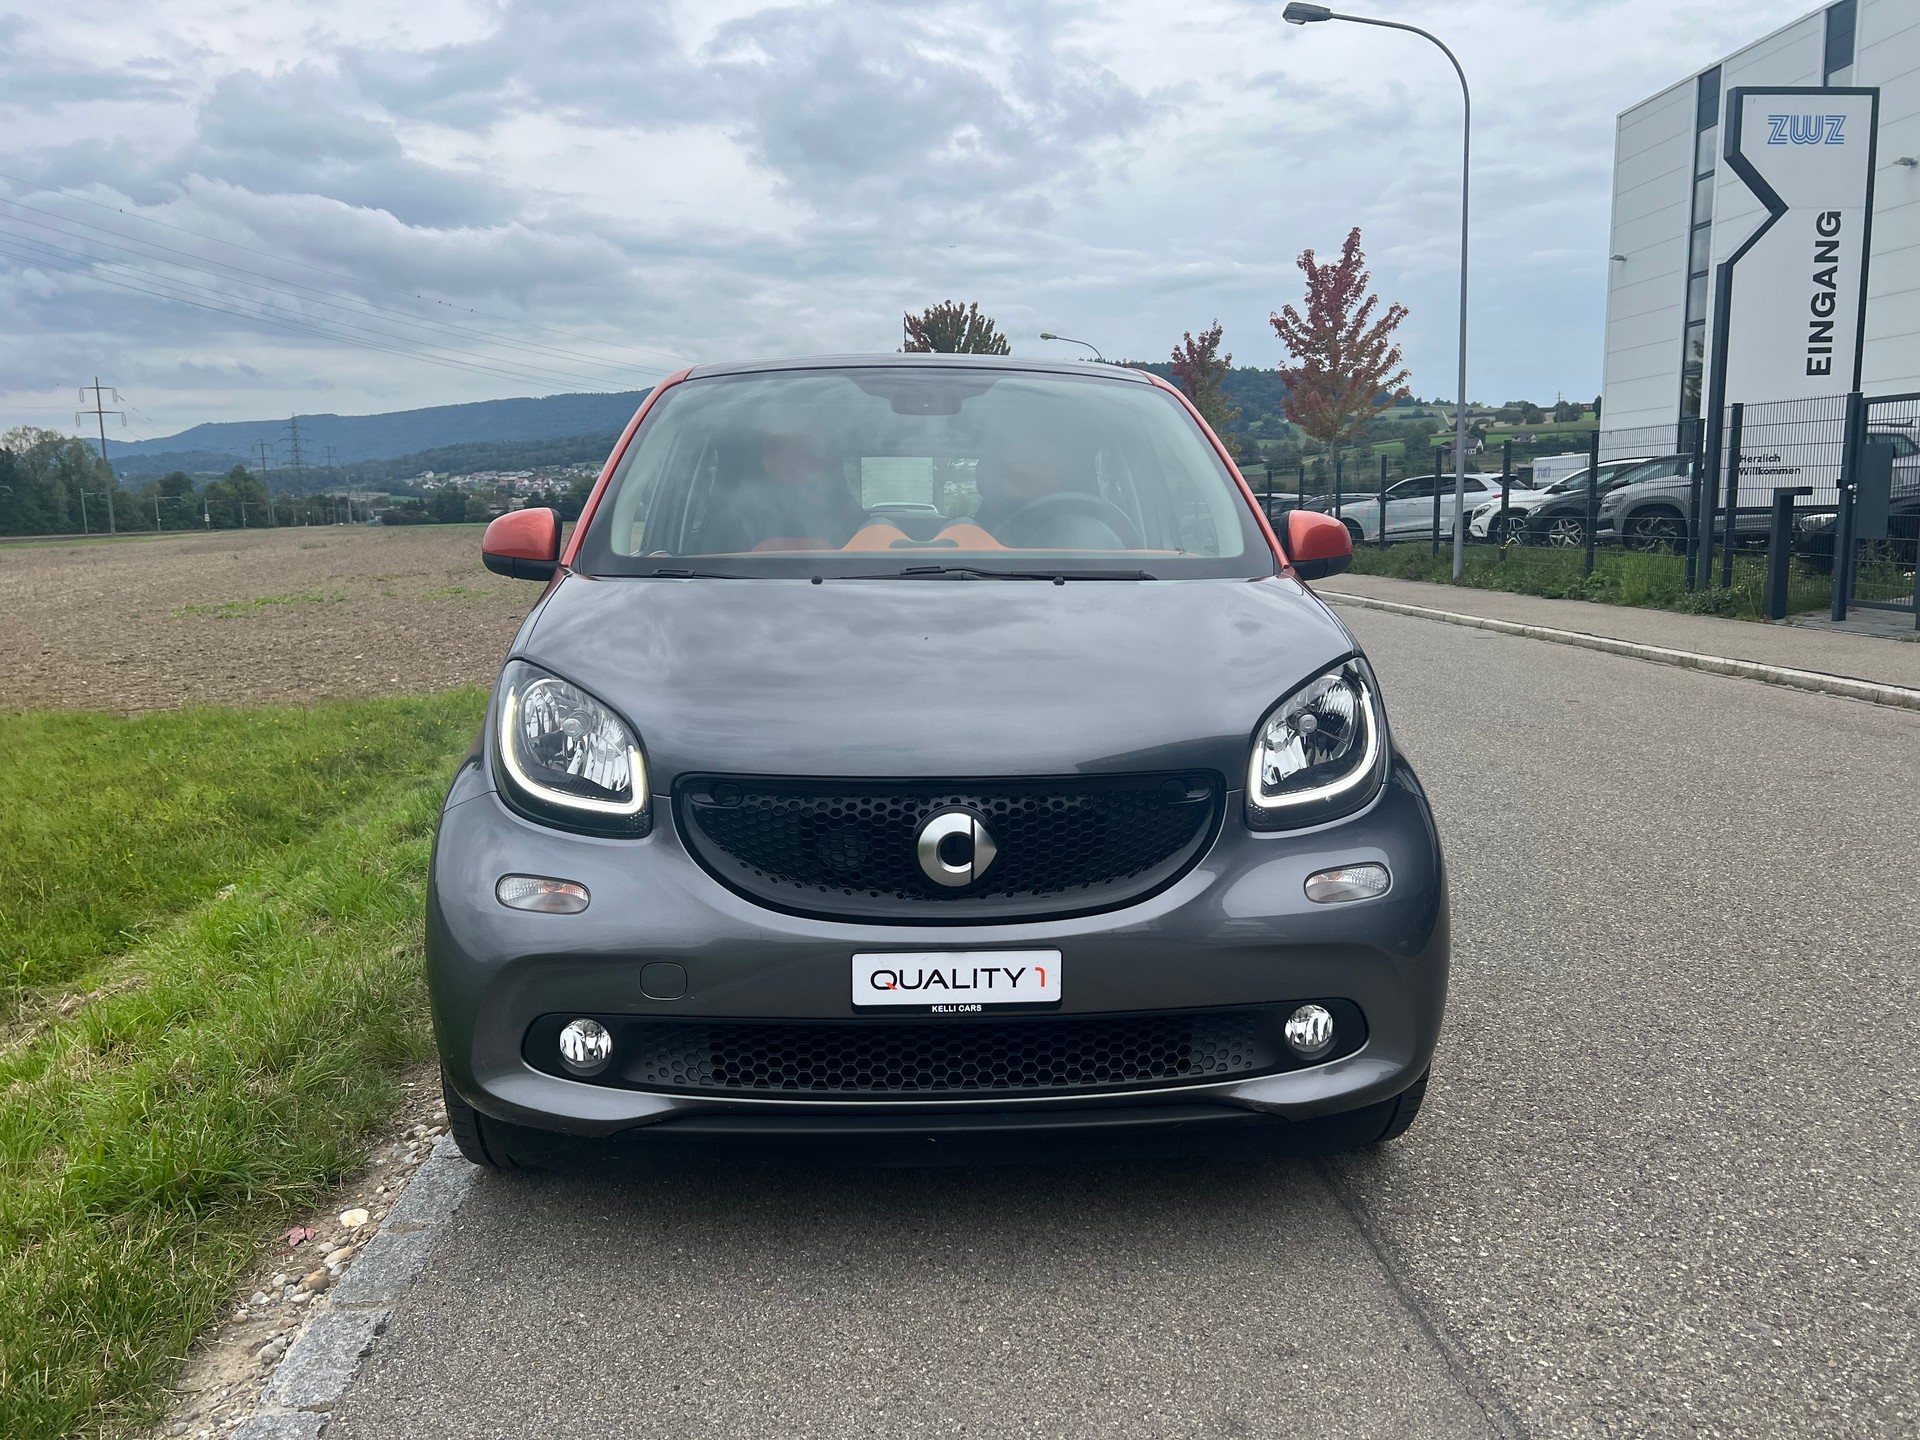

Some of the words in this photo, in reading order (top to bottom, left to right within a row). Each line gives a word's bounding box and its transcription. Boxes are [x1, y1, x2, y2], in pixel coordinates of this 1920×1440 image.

[1767, 114, 1846, 145] ZWZ
[1806, 210, 1842, 376] EINGANG
[1739, 454, 1781, 463] Herzlich
[1739, 467, 1801, 476] Willkommen
[931, 1005, 957, 1013] KELLI
[958, 1004, 982, 1013] CARS
